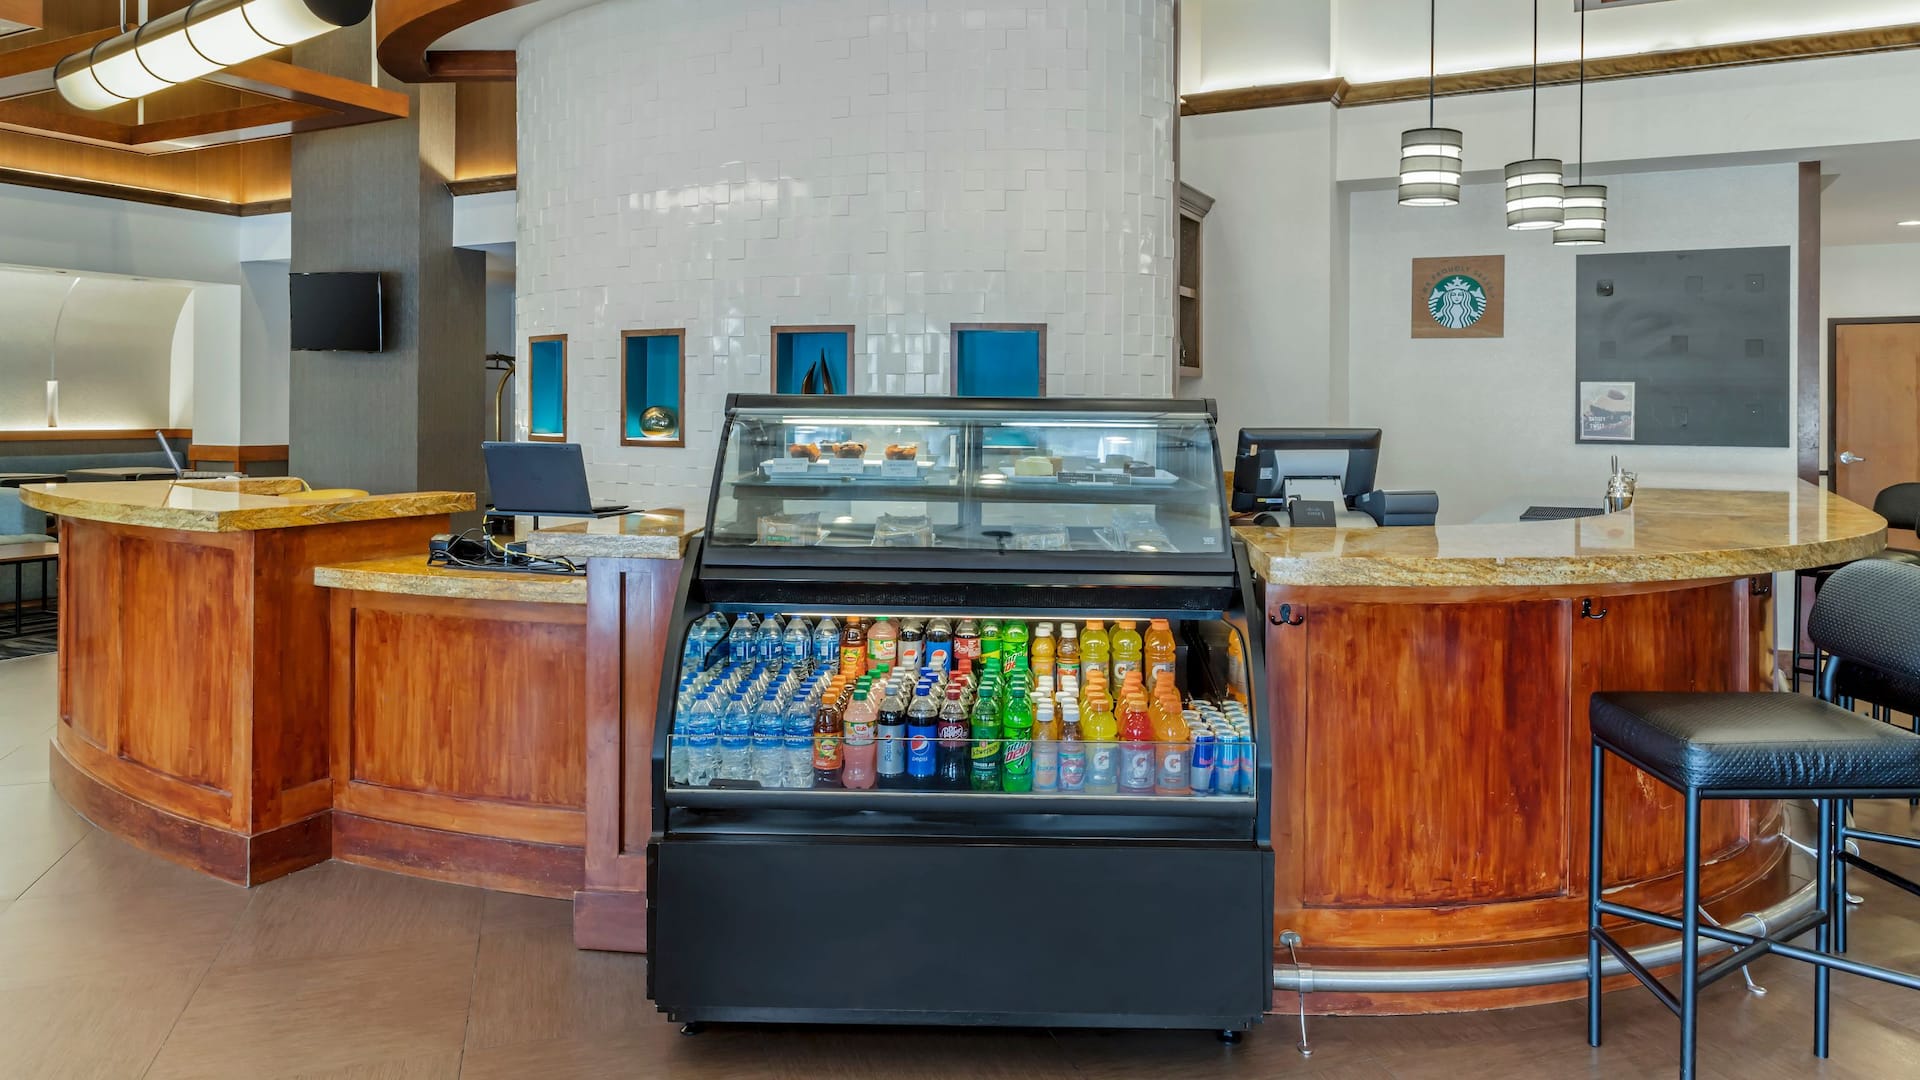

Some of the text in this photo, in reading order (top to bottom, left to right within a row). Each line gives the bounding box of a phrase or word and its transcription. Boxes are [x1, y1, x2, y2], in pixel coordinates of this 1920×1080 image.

[1093, 751, 1109, 770] G
[1131, 753, 1148, 774] G
[1164, 754, 1181, 773] G
